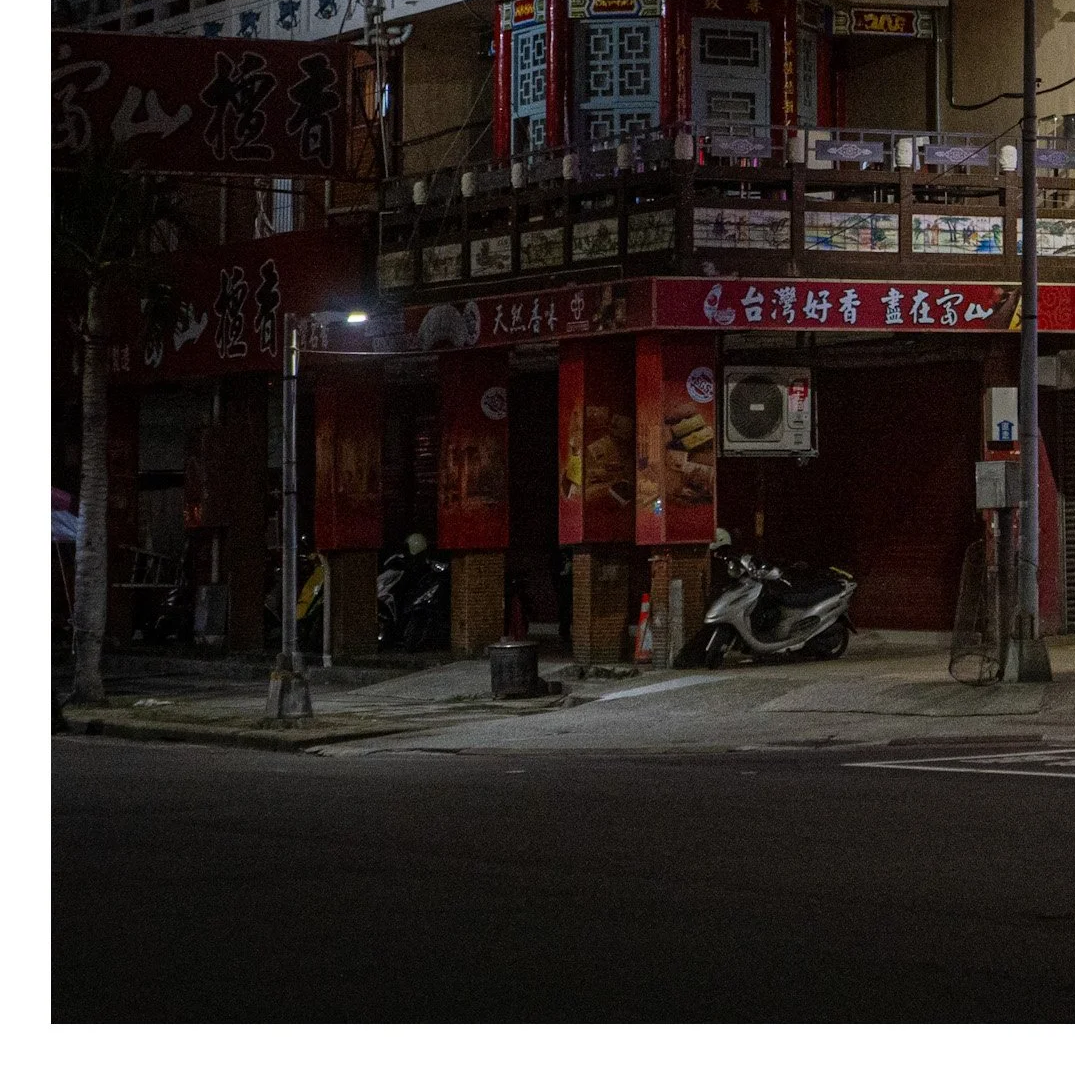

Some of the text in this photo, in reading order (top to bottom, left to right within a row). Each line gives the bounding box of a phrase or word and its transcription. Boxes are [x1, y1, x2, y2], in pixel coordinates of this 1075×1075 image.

[740, 285, 993, 326] 台灣好香 盡在富山
